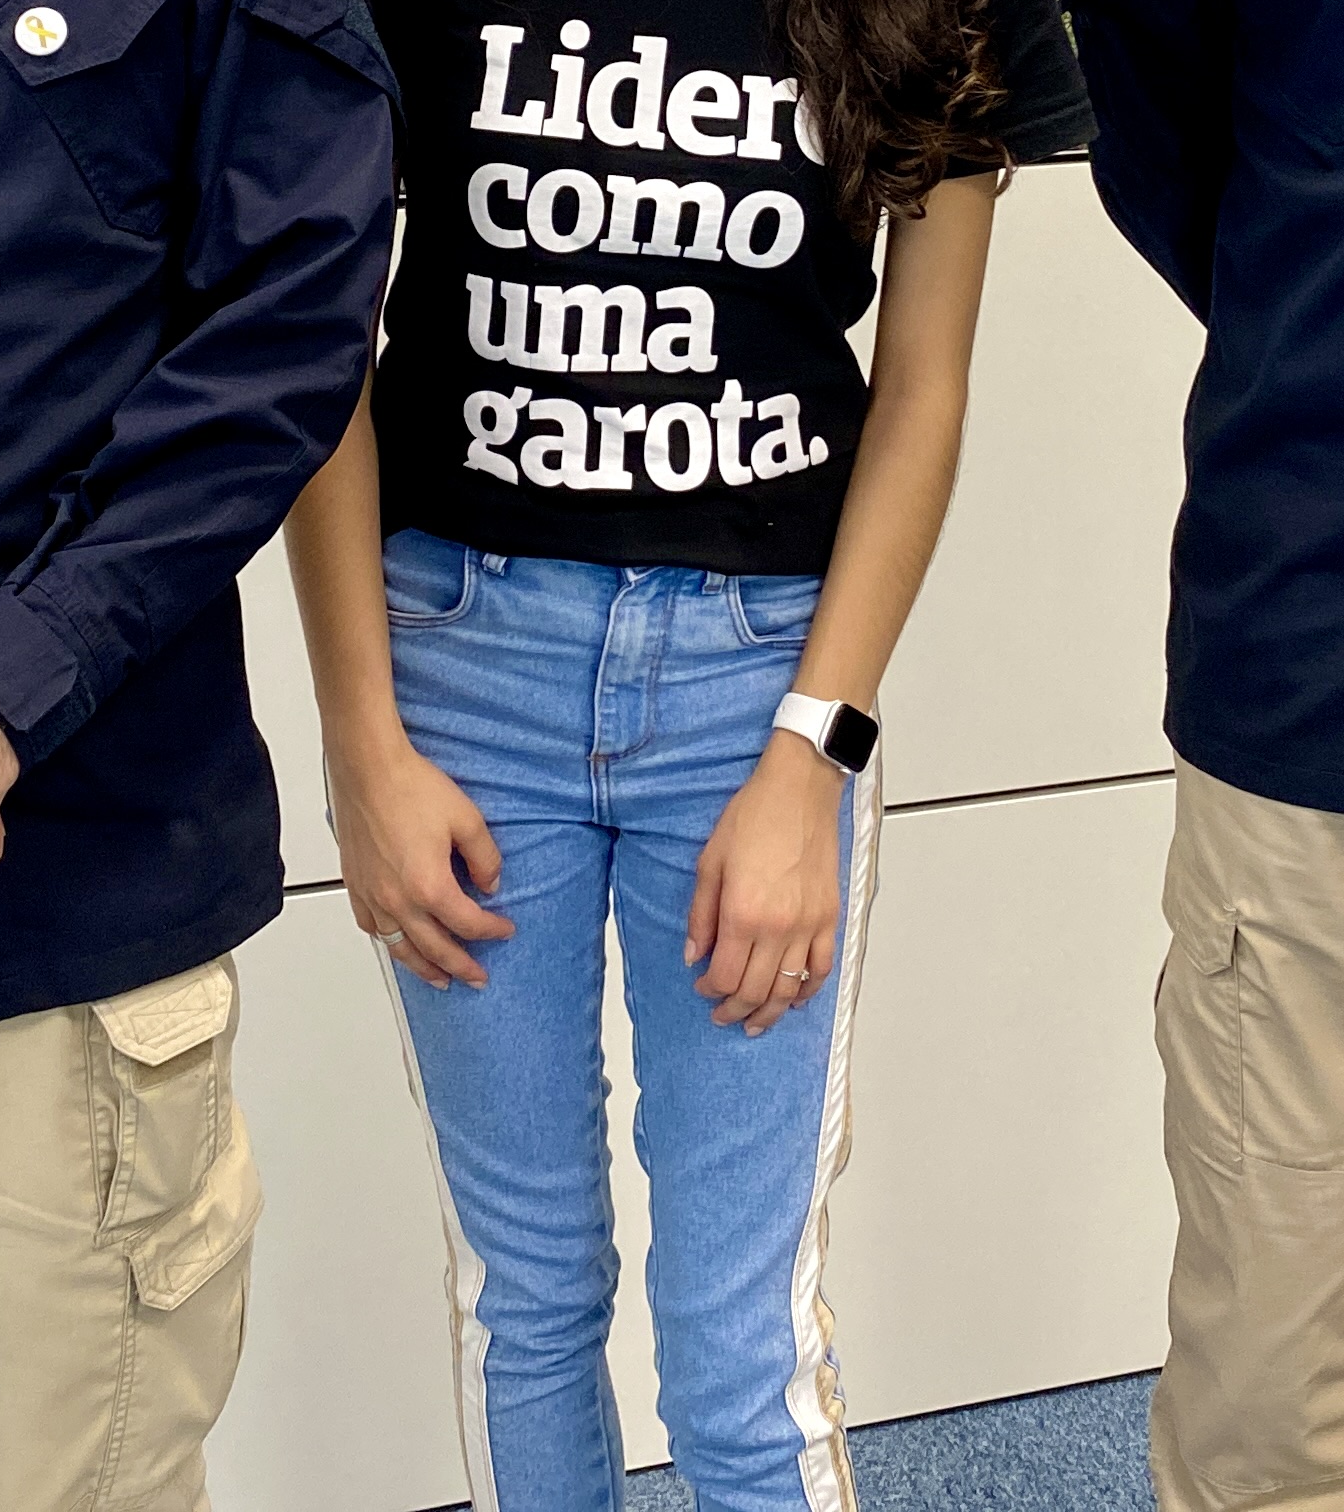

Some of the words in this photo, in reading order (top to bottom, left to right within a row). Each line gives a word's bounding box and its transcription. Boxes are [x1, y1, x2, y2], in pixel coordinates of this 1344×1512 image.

[467, 162, 805, 269] como
[465, 272, 718, 374] uma
[462, 379, 829, 492] garota.
